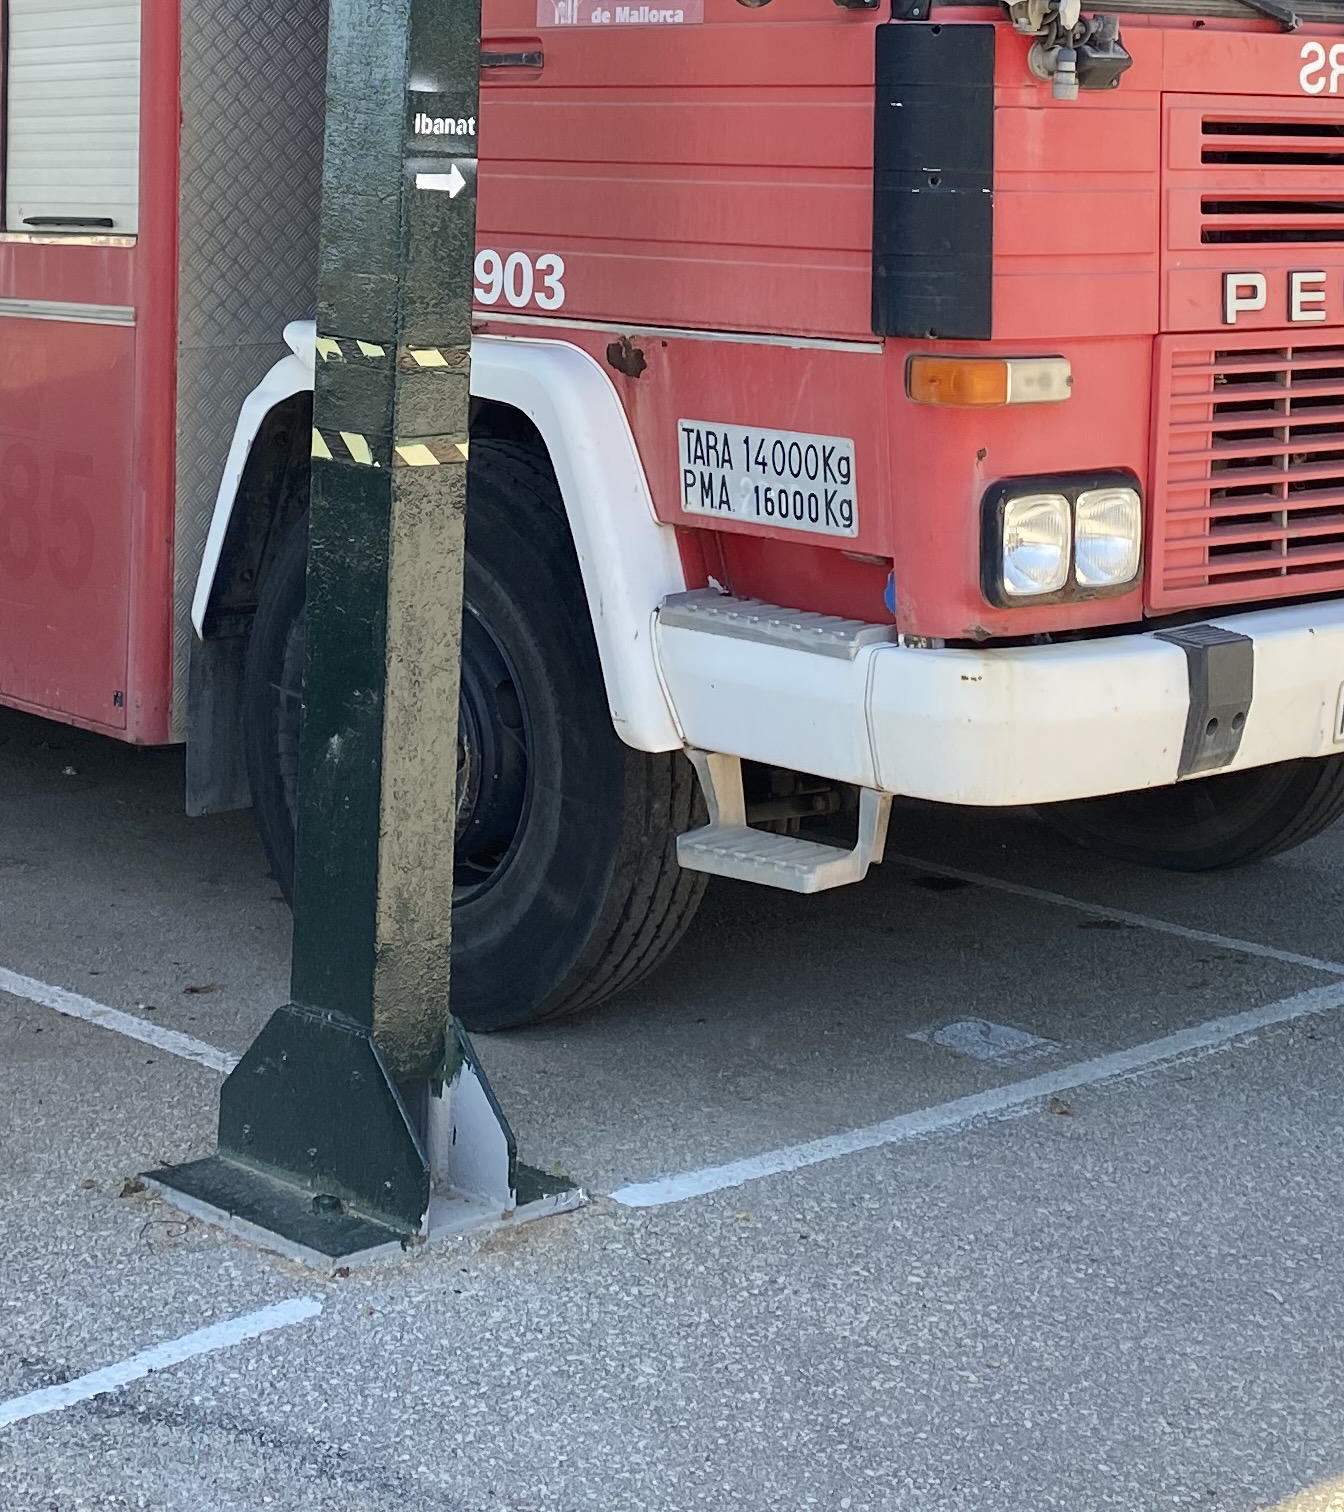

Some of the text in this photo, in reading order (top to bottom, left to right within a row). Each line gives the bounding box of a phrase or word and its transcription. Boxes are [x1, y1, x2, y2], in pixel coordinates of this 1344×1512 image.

[591, 6, 684, 24] de Mallorca
[414, 112, 476, 136] Ibanat
[474, 249, 566, 311] 903
[682, 427, 734, 471] TARA
